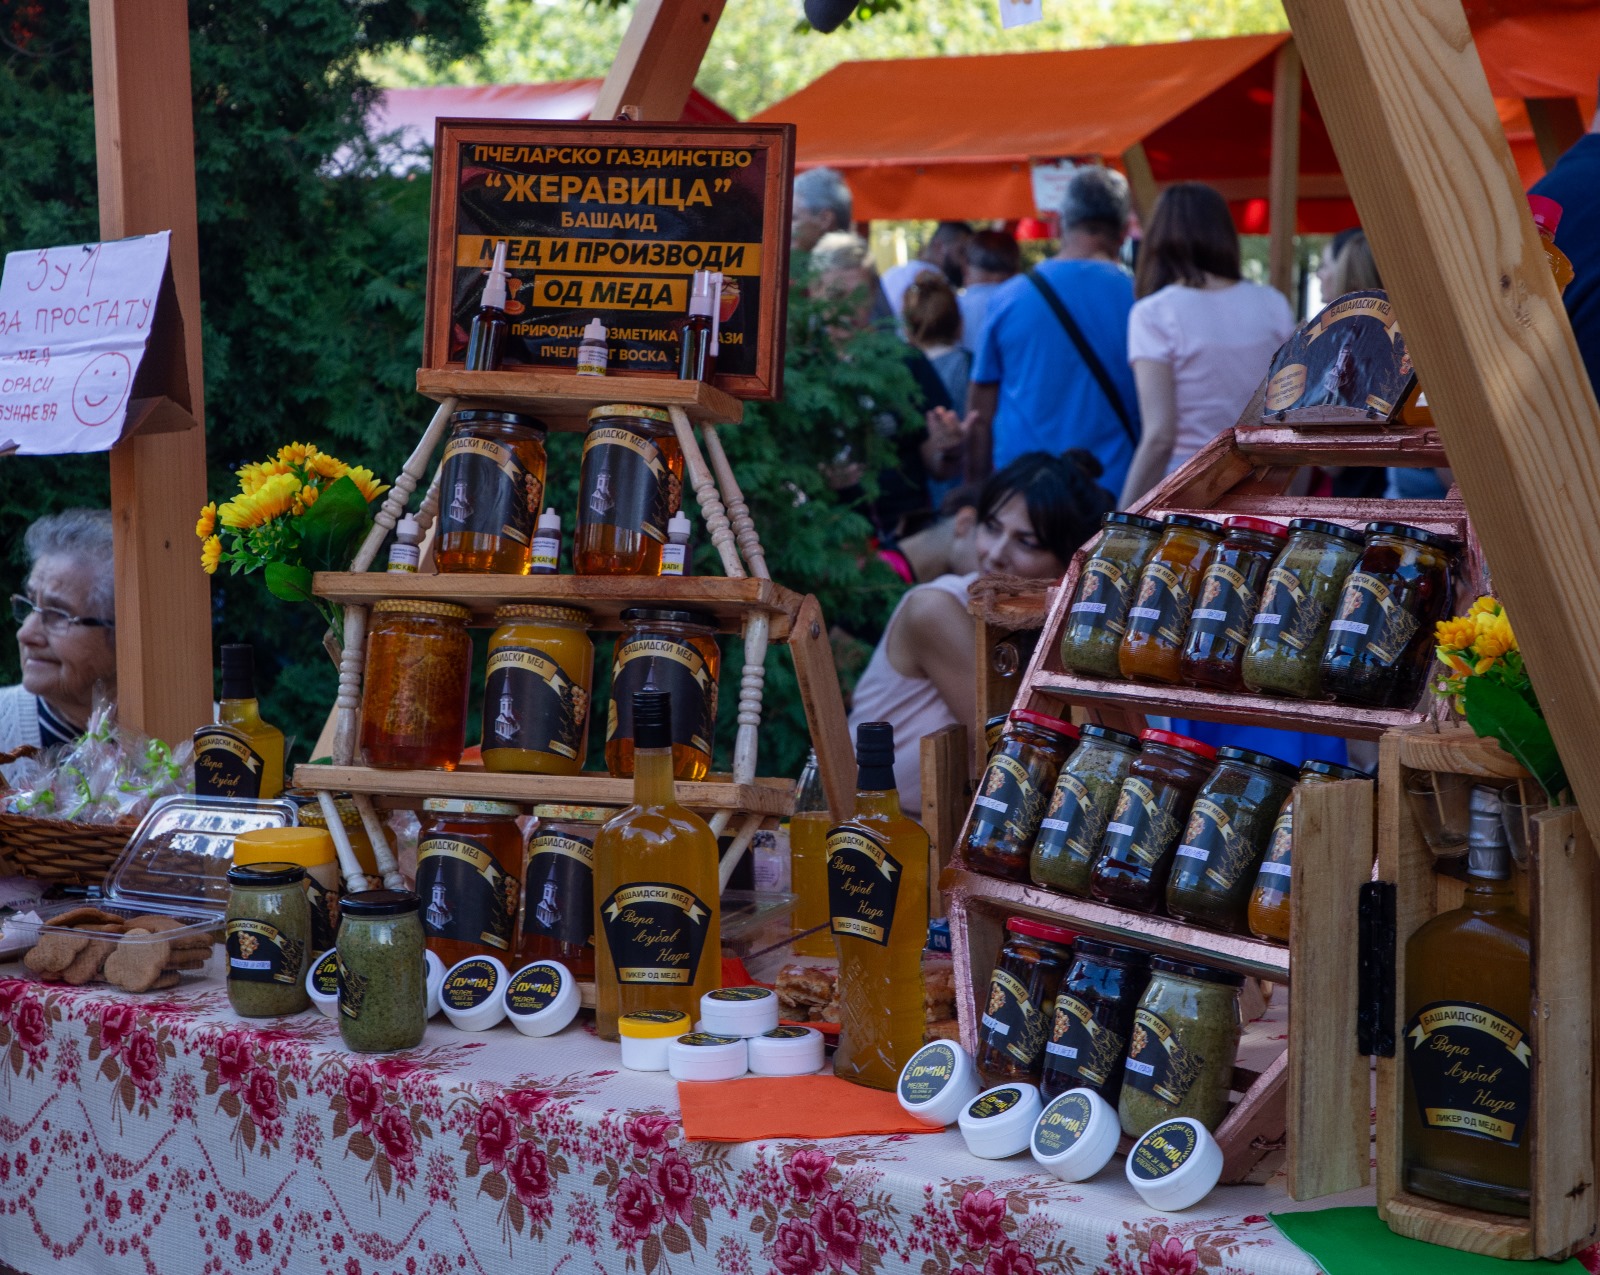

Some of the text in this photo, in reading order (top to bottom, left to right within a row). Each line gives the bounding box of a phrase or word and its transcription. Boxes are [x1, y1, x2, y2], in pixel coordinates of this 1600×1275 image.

[473, 145, 752, 168] ПЧЕЛАРСКО ГАЗДИНСТВО
[561, 211, 657, 232] БАШАИД
[479, 239, 745, 271] МЕД И ПРОИЗВОДИ
[543, 280, 674, 308] ОД МЕДА
[35, 298, 152, 334] ПРОСТАТУ
[1330, 299, 1392, 317] БАШАИДСКИ МЕД
[604, 327, 678, 343] ОЗМЕТИКА
[619, 349, 668, 363] ВОСКА
[2, 376, 55, 393] ОРАСИ
[0, 404, 58, 421] БУНДЕВА
[481, 441, 500, 455] МЕД
[629, 435, 647, 451] МЕД
[623, 641, 694, 662] БАШАИДСКИ МЕД
[526, 655, 544, 670] МЕД
[232, 743, 247, 756] МЕД
[200, 754, 224, 771] Вера
[461, 845, 480, 860] МЕД
[531, 839, 576, 850] БАШАИДСКИ
[866, 843, 882, 858] МЕД
[832, 855, 856, 875] Вера
[617, 889, 690, 906] БАШАИДСКИ МЕД
[857, 899, 884, 919] Нада
[621, 909, 655, 927] Вера
[260, 925, 275, 935] МЕД
[861, 925, 876, 935] МЕДА
[655, 948, 690, 966] Нада
[625, 971, 681, 980] ЛИКЕР ОД МЕДА
[1423, 1011, 1515, 1040] БАШАИДСКИ МЕД
[1430, 1034, 1470, 1058] Вера
[1472, 1088, 1517, 1114] Нада
[1435, 1114, 1503, 1133] ЛИКЕР ОД МЕДА
